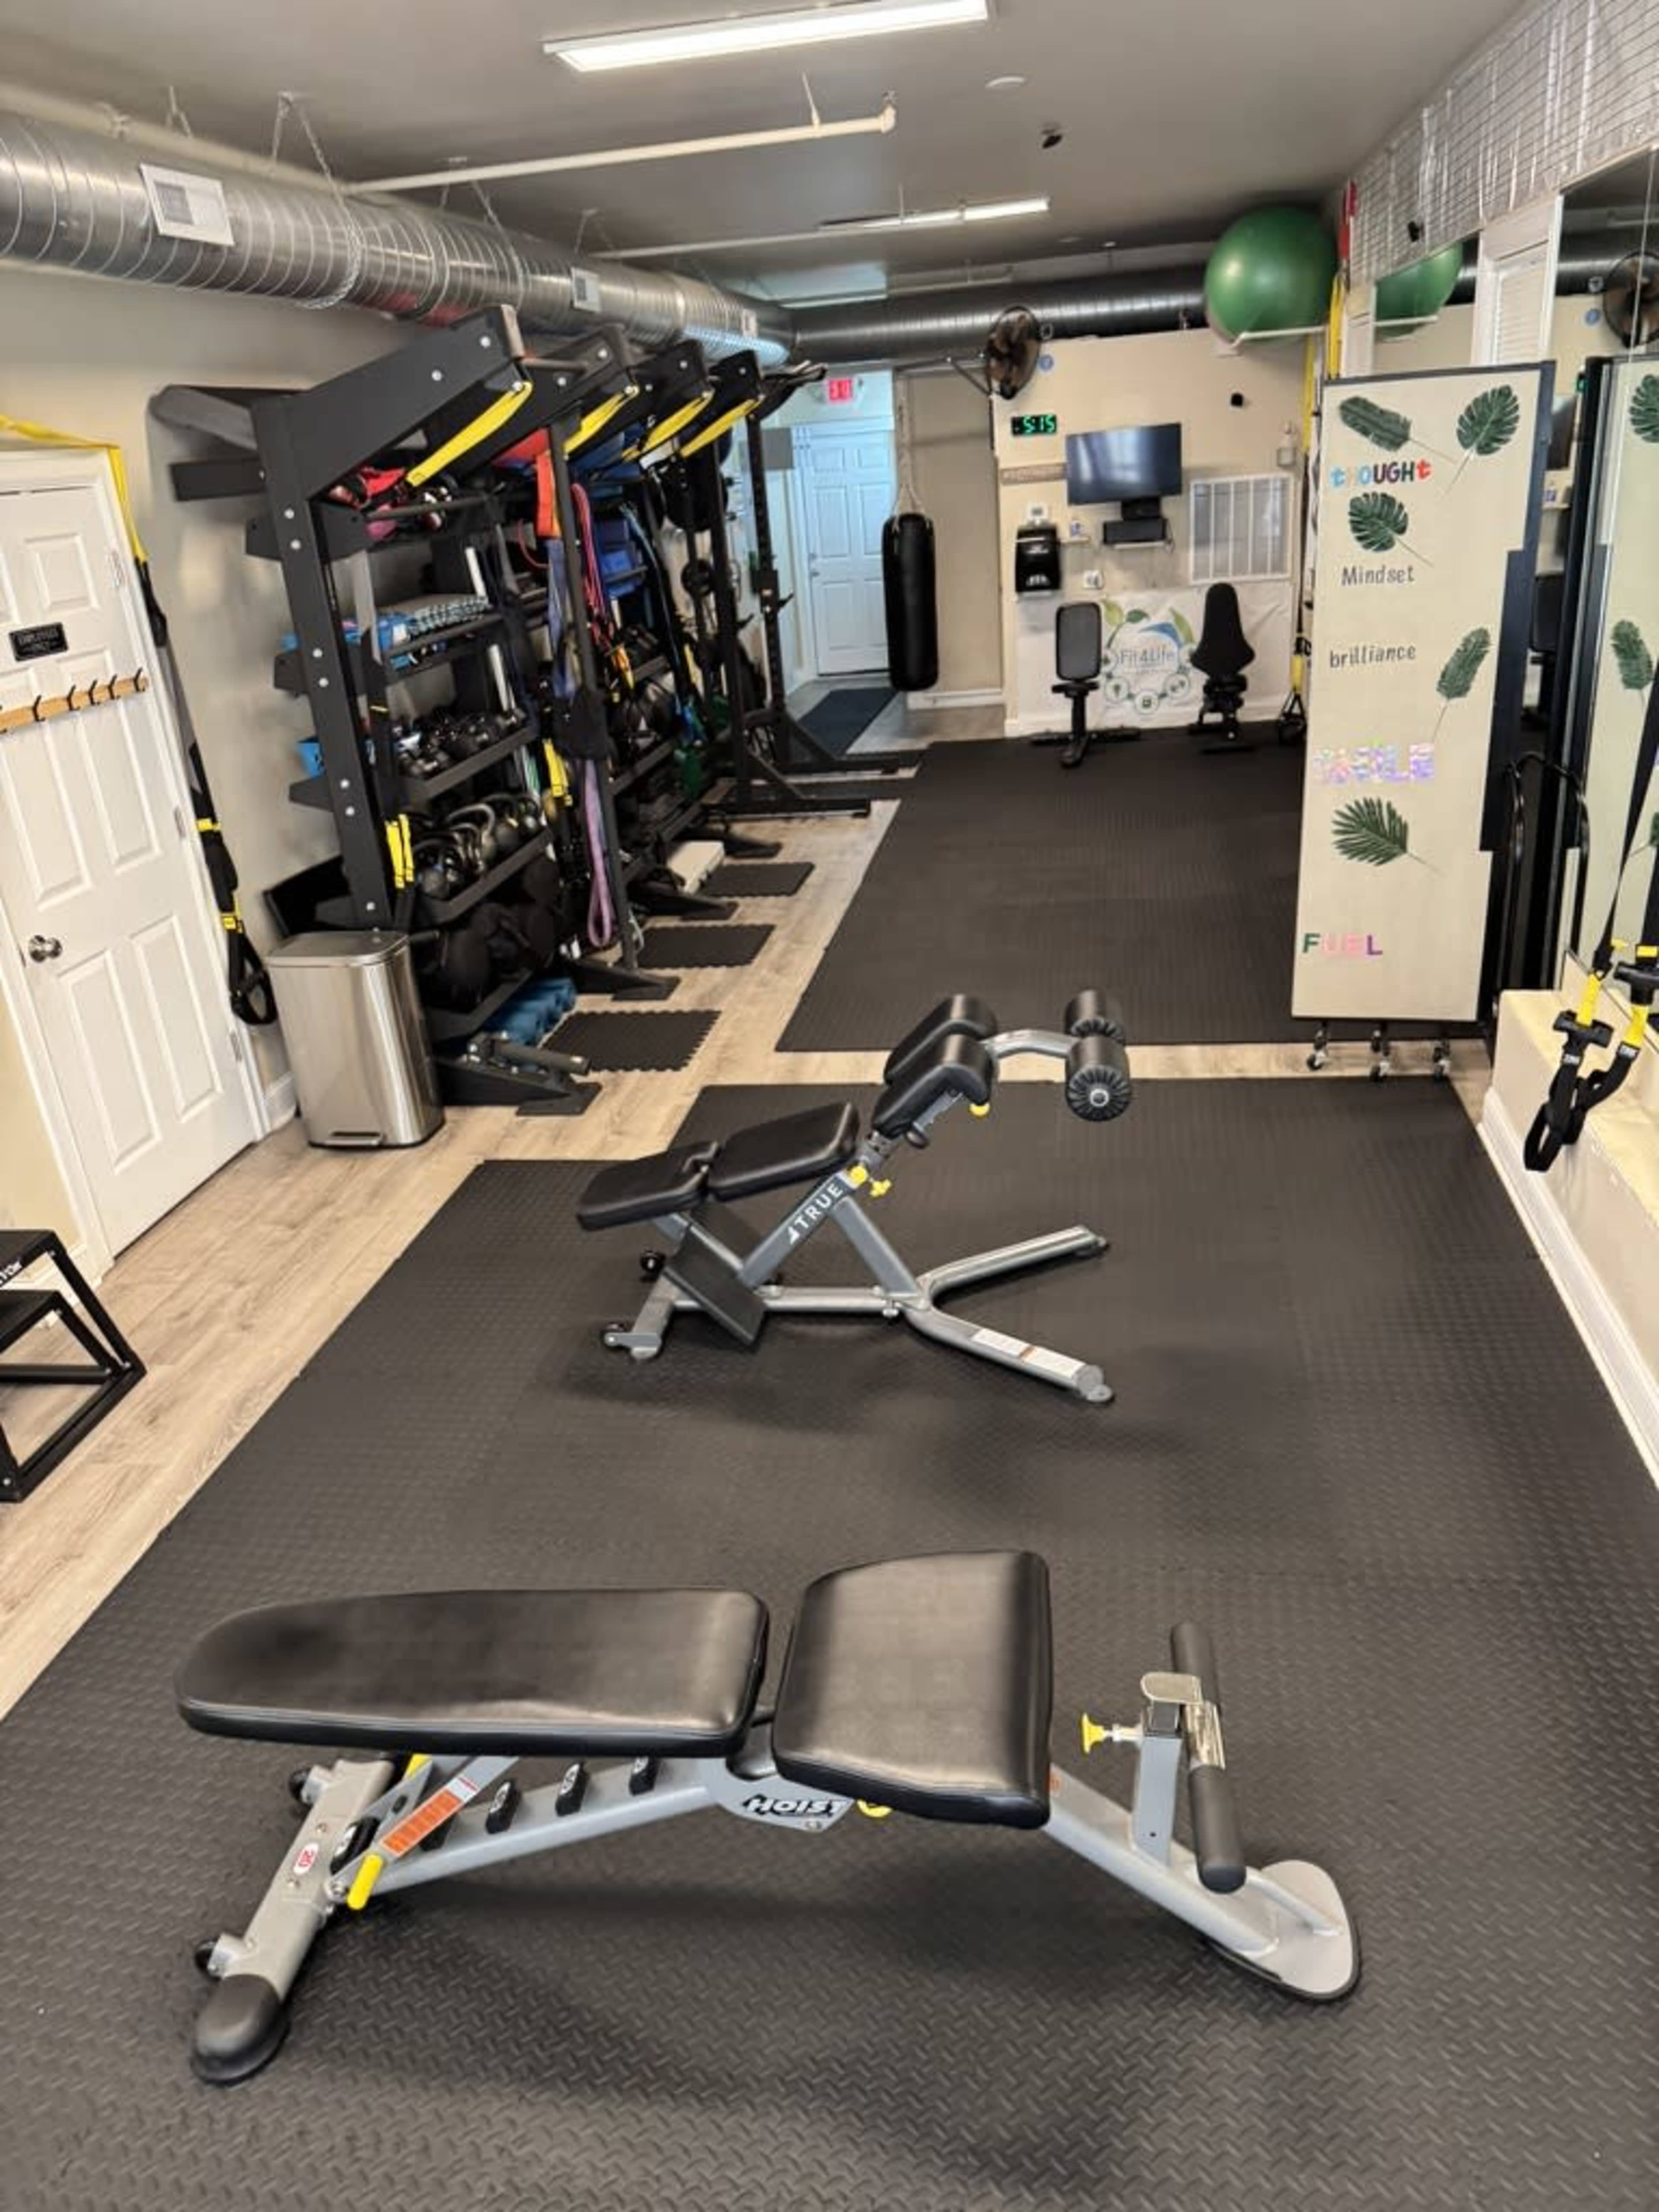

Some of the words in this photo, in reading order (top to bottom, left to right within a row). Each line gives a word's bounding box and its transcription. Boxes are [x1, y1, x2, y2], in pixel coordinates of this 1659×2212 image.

[1023, 413, 1055, 433] 5:15
[1331, 459, 1431, 486] tOUGHt
[1341, 564, 1415, 586] Mindset
[1329, 645, 1416, 668] brilliance
[1302, 933, 1383, 956] FUEL
[794, 1183, 843, 1229] TRUE
[743, 1794, 848, 1817] HOIST
